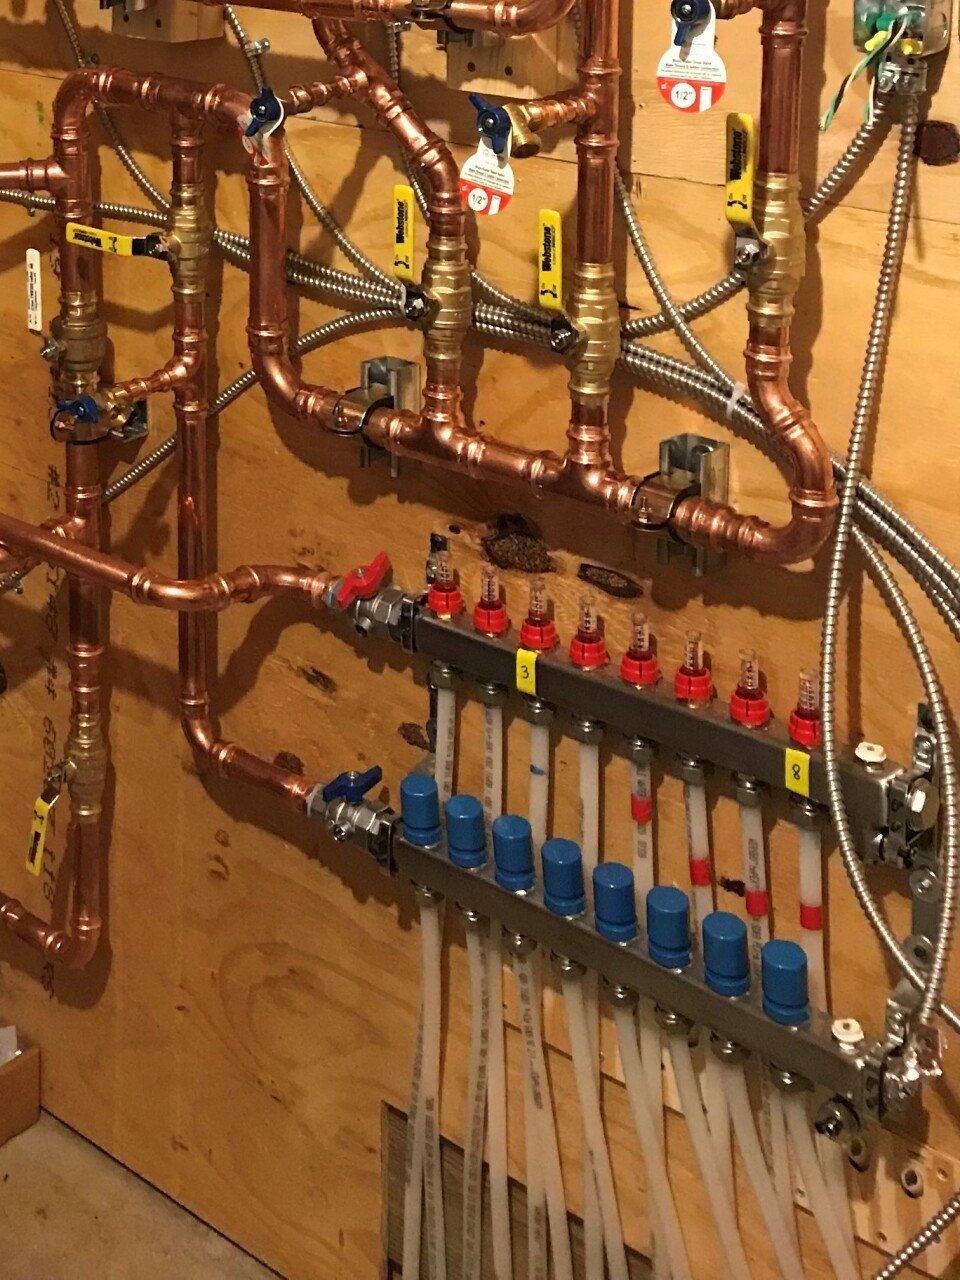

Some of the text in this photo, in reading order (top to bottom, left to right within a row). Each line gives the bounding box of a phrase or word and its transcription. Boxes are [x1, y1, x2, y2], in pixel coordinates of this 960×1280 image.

[675, 90, 693, 101] 1/2"
[729, 129, 743, 180] Webstone
[395, 199, 405, 243] Webstone
[542, 225, 551, 271] Webstone
[521, 665, 529, 679] 3
[792, 764, 800, 780] 8
